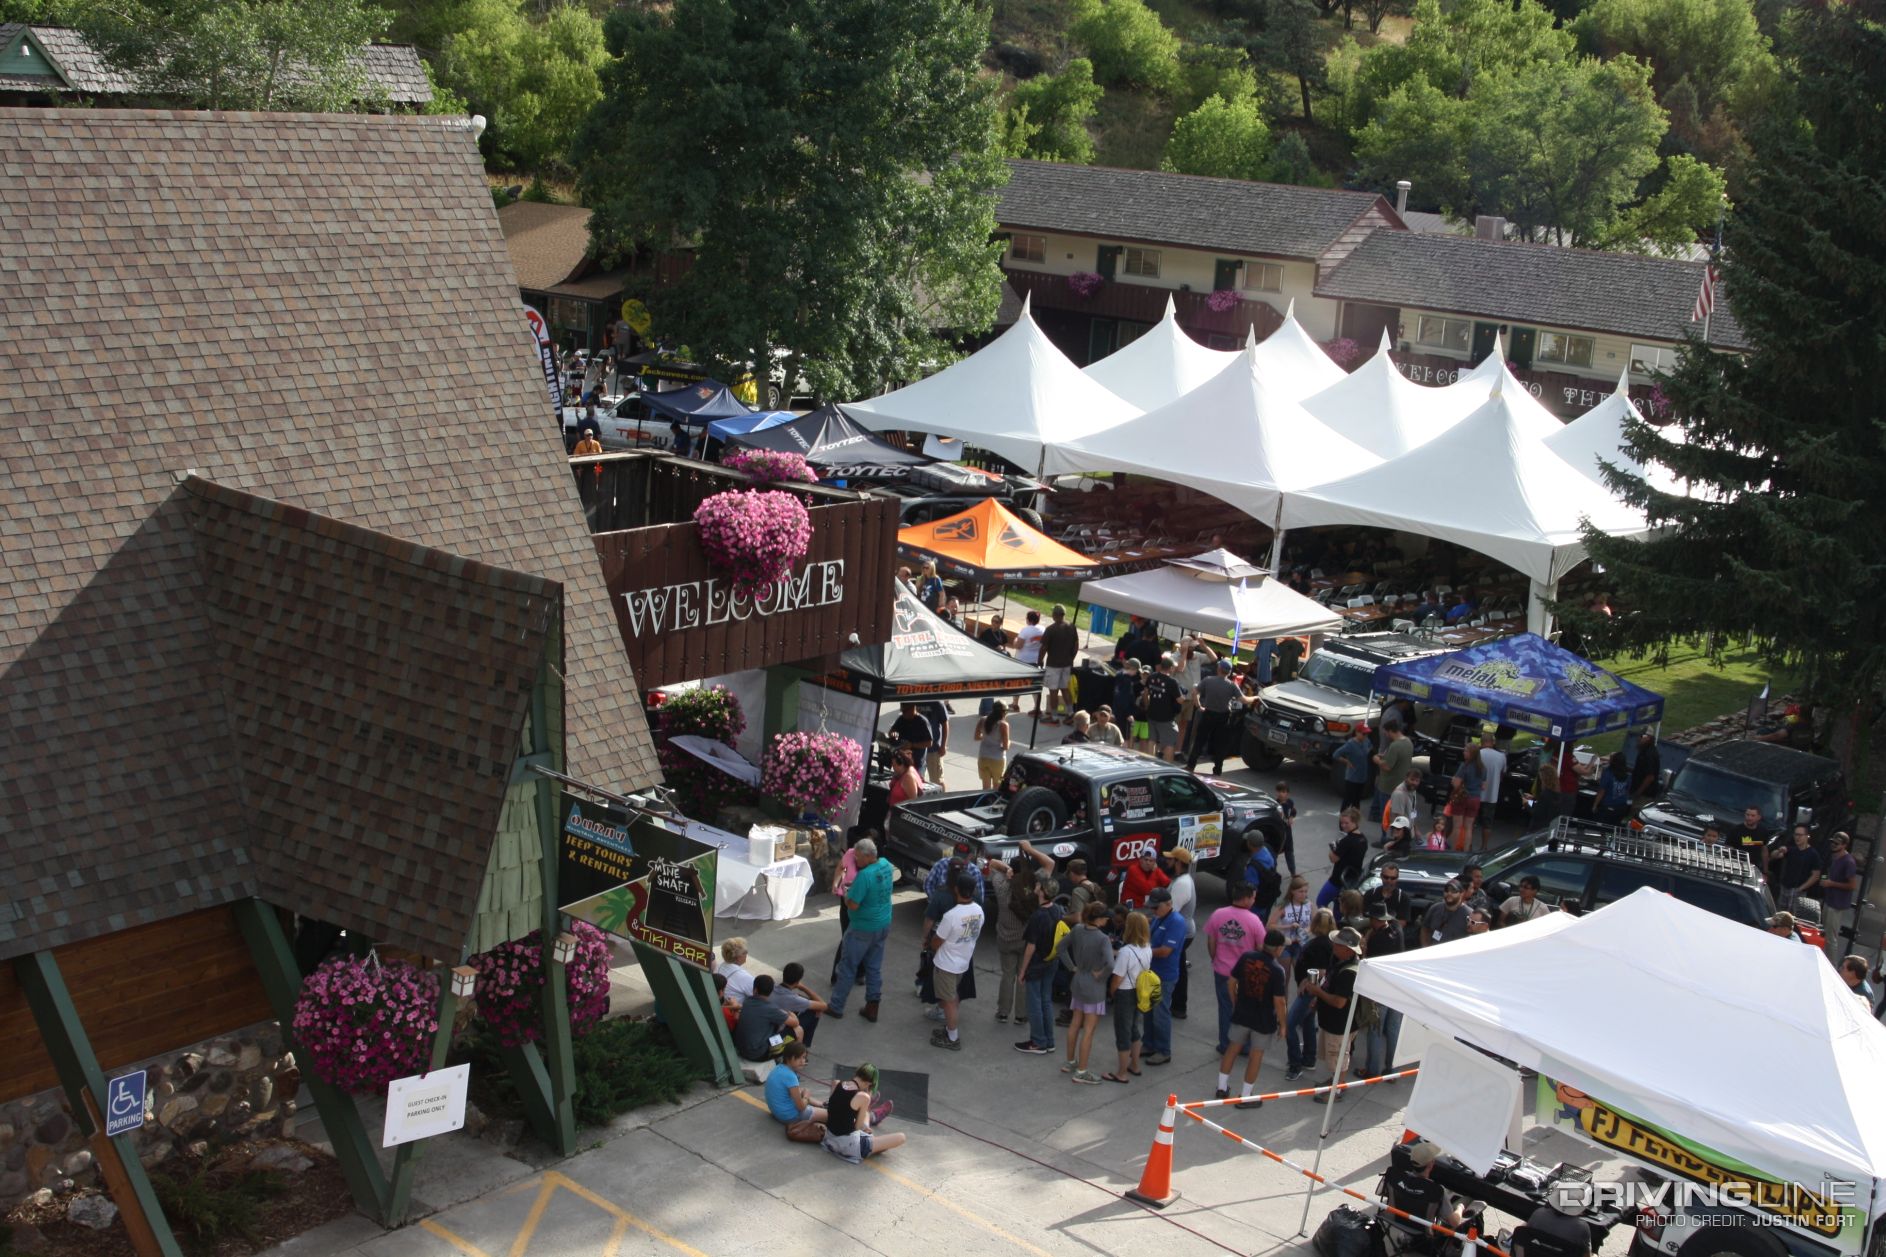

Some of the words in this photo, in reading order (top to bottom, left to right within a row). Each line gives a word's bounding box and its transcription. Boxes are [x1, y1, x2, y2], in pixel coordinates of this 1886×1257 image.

[820, 435, 867, 451] TOYTEC
[825, 465, 911, 477] TOYTEC
[620, 559, 844, 639] WELCOME
[571, 814, 627, 843] OURAY
[565, 834, 592, 850] JEEP
[594, 845, 633, 868] TOURS
[580, 854, 630, 881] RENTALS
[654, 863, 681, 879] MINE
[657, 874, 690, 894] SHAFT
[631, 918, 640, 931] &
[639, 927, 668, 950] TIKI
[672, 942, 707, 967] BAR
[109, 1112, 142, 1130] PARKING
[407, 1107, 431, 1119] PARKING
[1591, 1106, 1621, 1139] FJ
